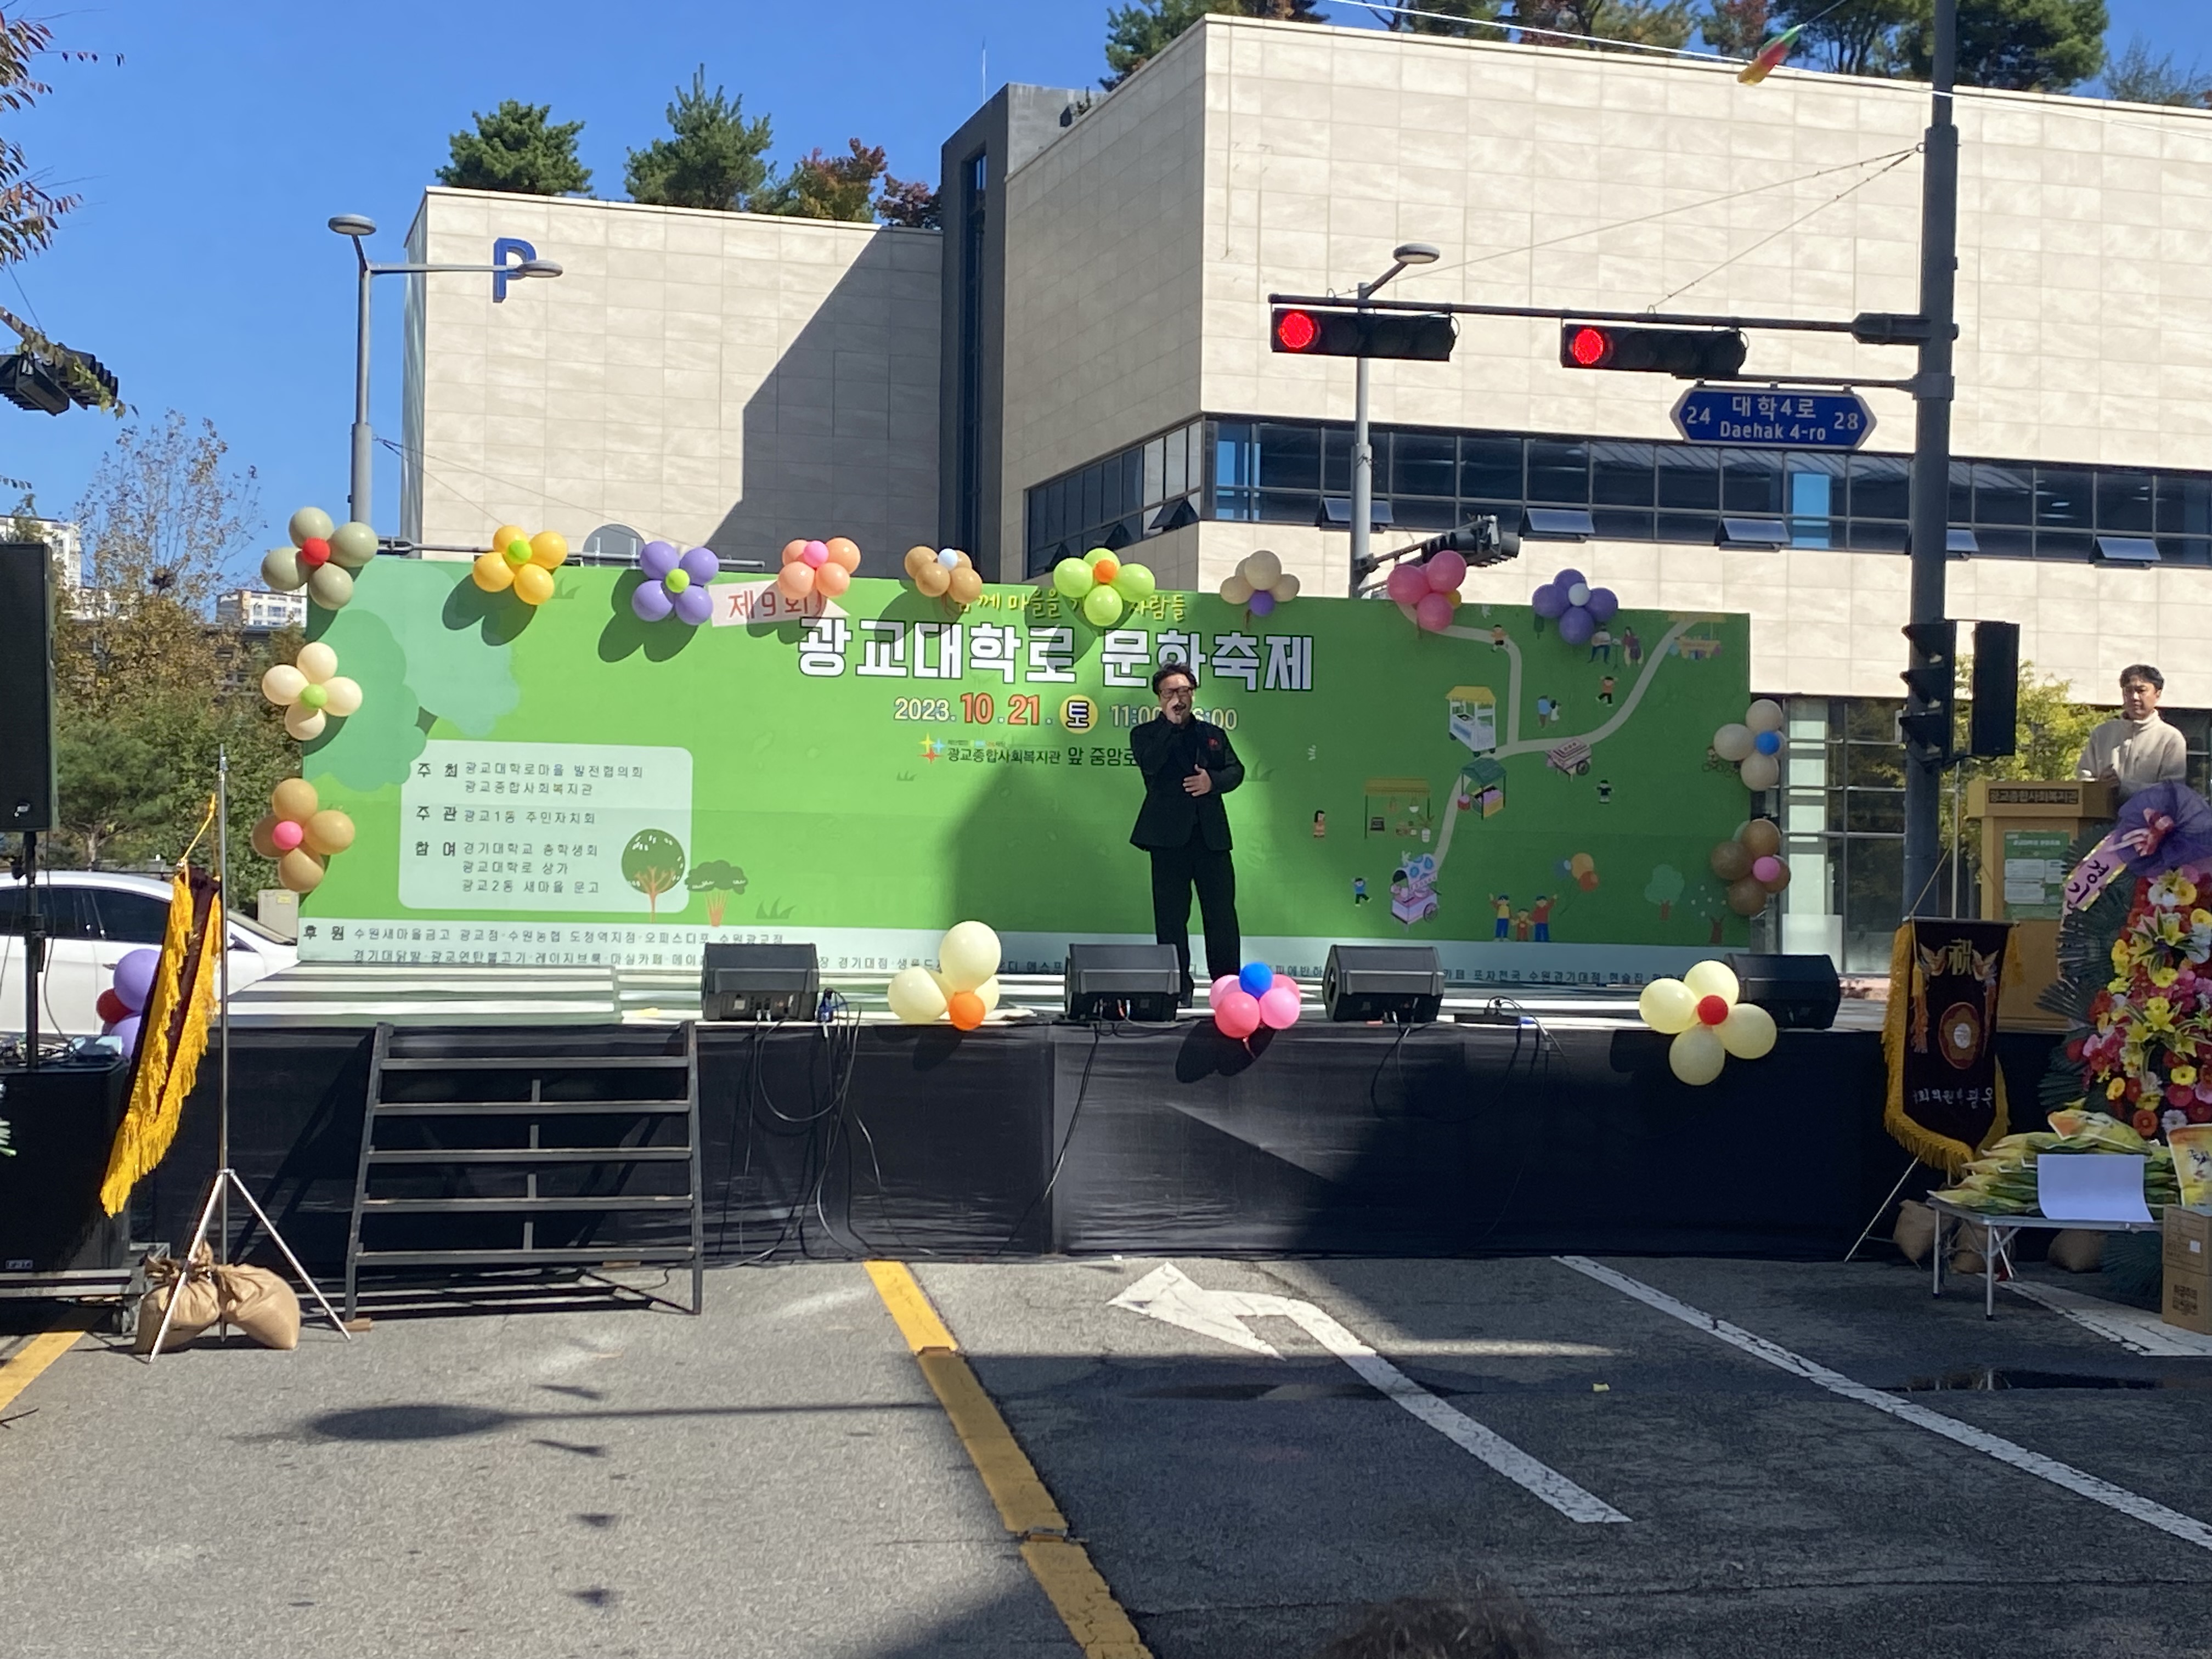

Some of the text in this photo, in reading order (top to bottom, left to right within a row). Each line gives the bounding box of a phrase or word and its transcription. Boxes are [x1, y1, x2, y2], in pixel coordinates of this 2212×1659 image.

[493, 237, 537, 303] P
[1686, 406, 1711, 425] 24
[1731, 396, 1816, 422] 대학4로
[1833, 412, 1859, 430] 28
[1719, 421, 1826, 441] Daehak 4-ro
[798, 616, 1314, 692] 광교대학로 문화축제
[1066, 699, 1090, 729] 토
[1192, 707, 1238, 731] 6:00
[947, 746, 1061, 765] 광교종합사회복지관
[1068, 746, 1084, 766] 앞
[465, 761, 564, 777] 광교대학로마을
[574, 764, 644, 779] 발전협의회
[464, 780, 593, 796] 광교종합사회복지관
[463, 842, 534, 856] 경기대학교
[543, 843, 598, 857] 총학생회
[462, 860, 568, 876] 광교대학로 상가
[523, 880, 564, 894] 새마을
[574, 881, 600, 895] 문고
[354, 928, 450, 941] 수원새마을금고
